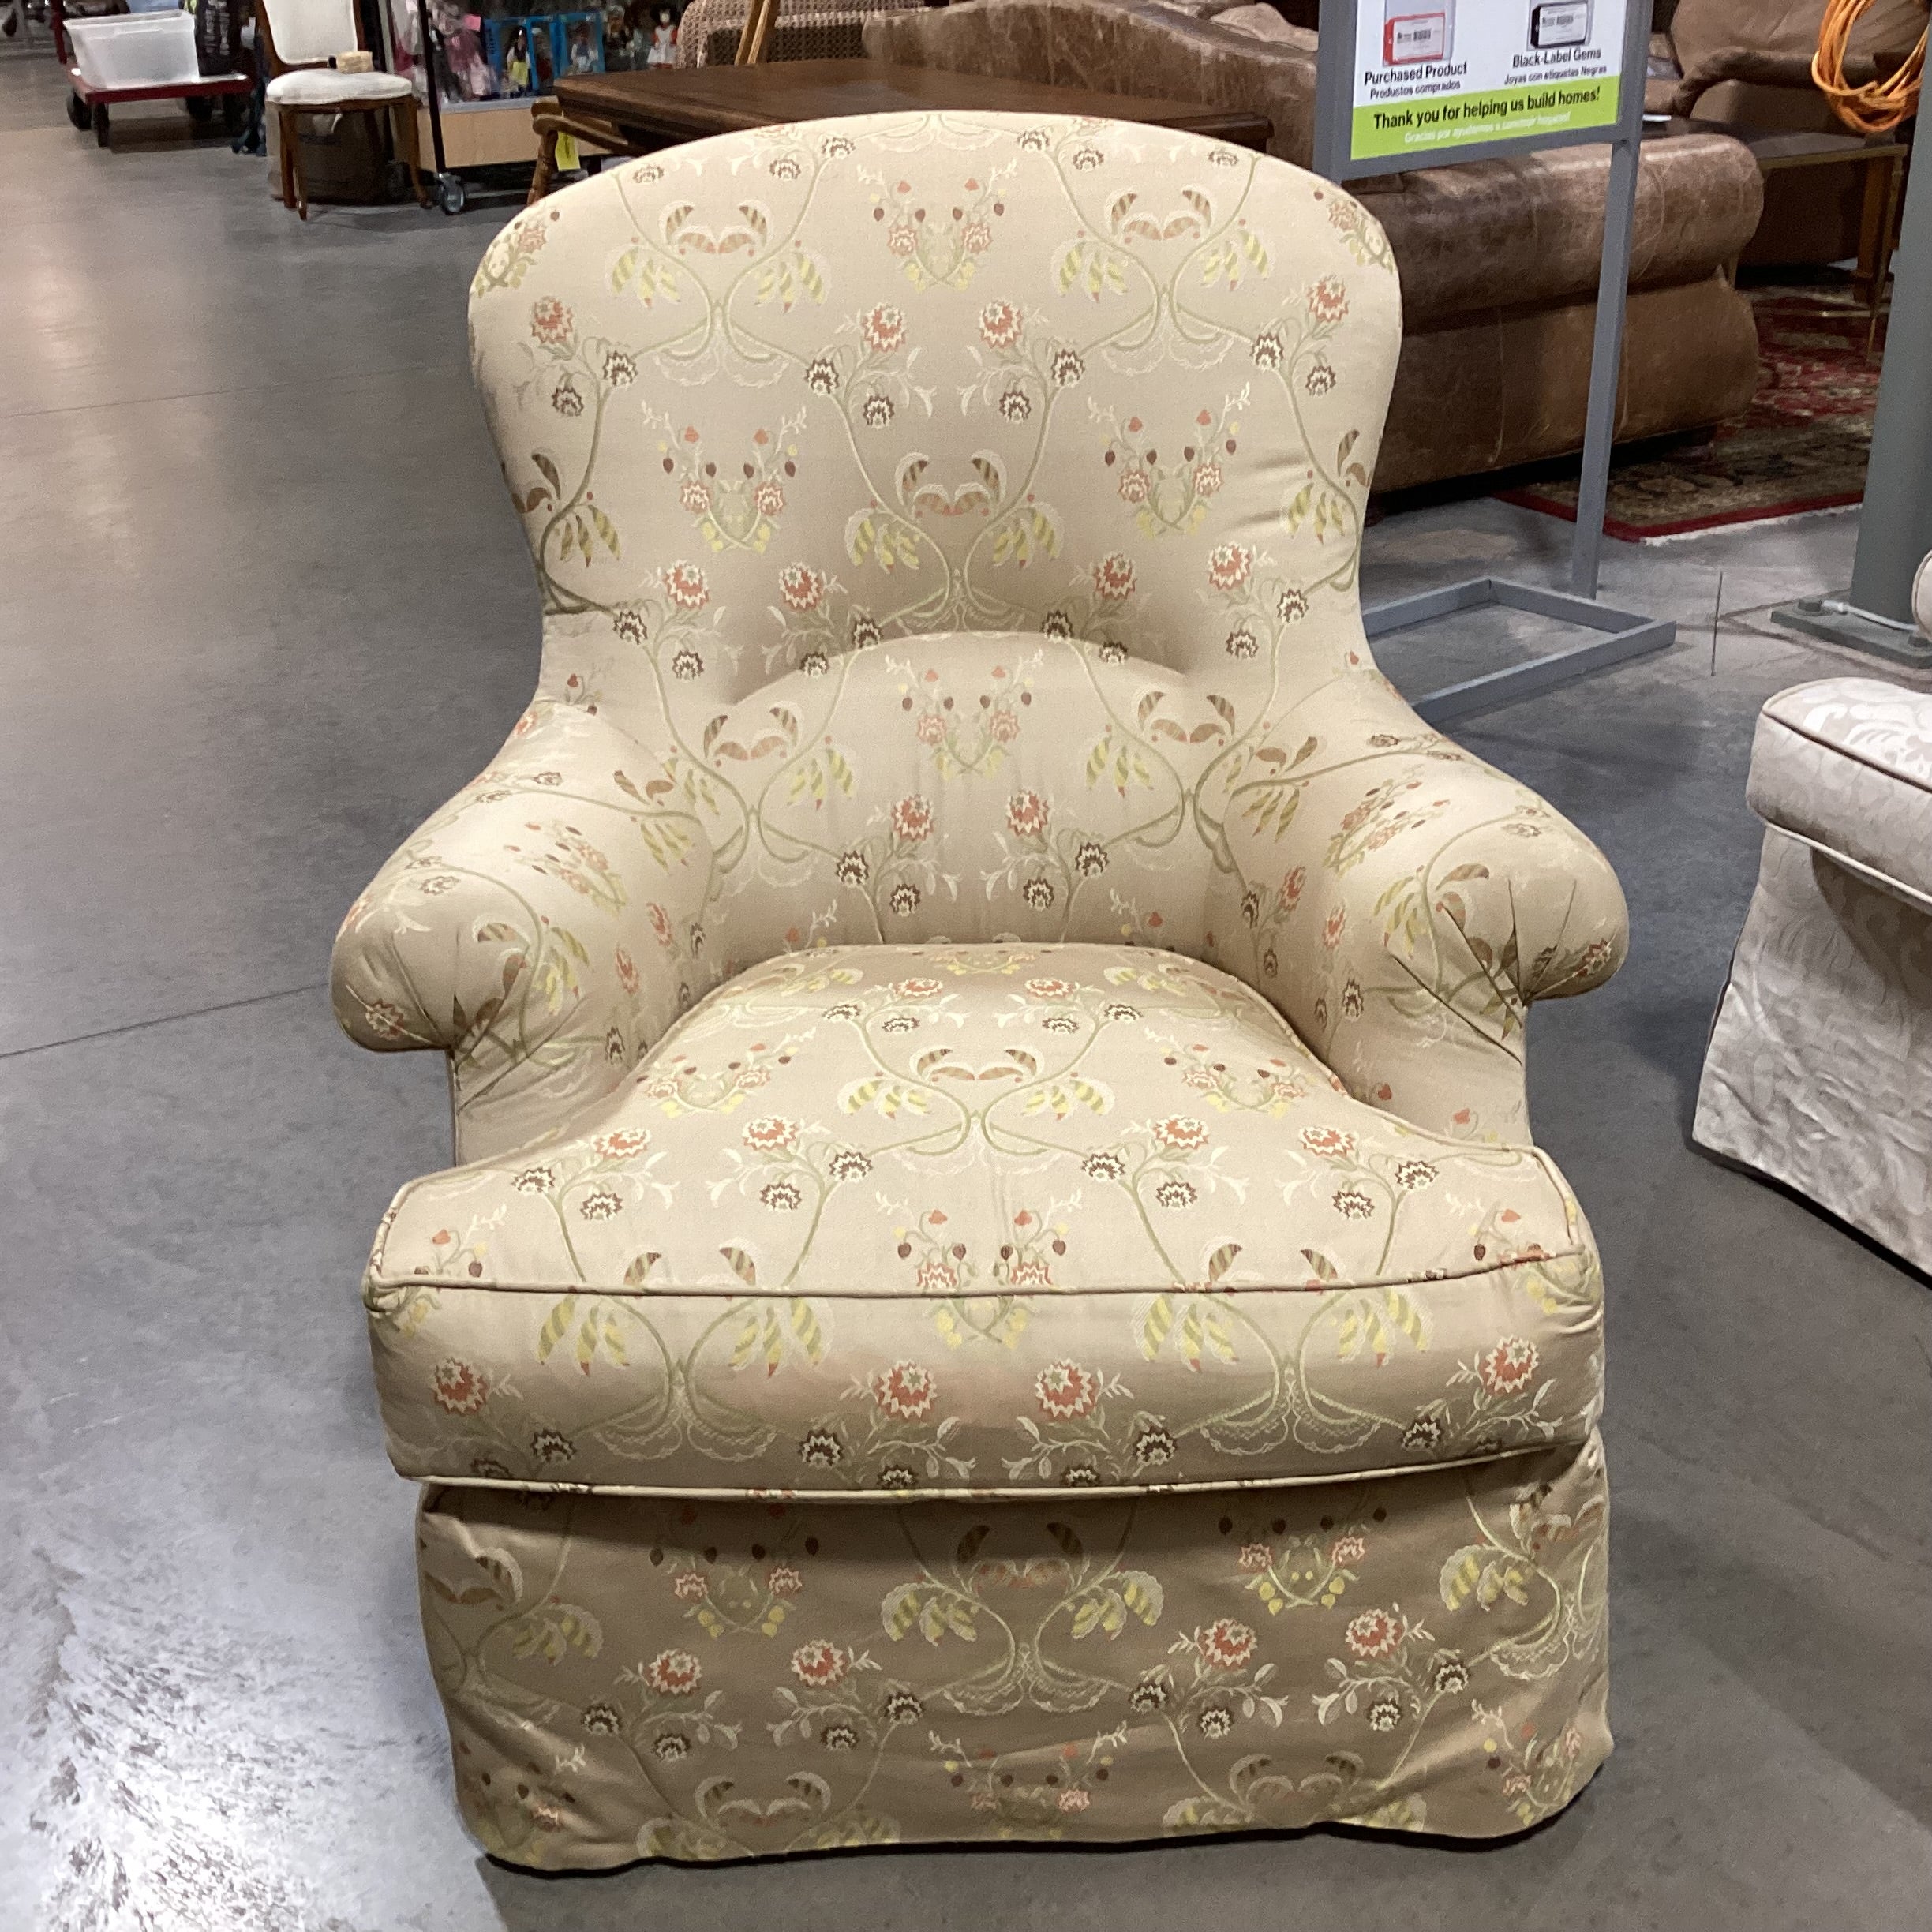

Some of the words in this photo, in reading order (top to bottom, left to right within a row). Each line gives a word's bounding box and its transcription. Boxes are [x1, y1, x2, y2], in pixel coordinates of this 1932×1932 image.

[1573, 48, 1601, 60] Gems
[1364, 66, 1423, 85] Purchased
[1425, 61, 1467, 79] Product
[1370, 85, 1414, 99] Productos
[1415, 80, 1461, 93] comprados
[1374, 109, 1413, 129] Thank
[1417, 109, 1440, 128] you
[1443, 103, 1460, 121] for
[1464, 98, 1508, 118] helping
[1511, 99, 1524, 111] us
[1527, 89, 1556, 110] build
[1558, 86, 1601, 105] homes!
